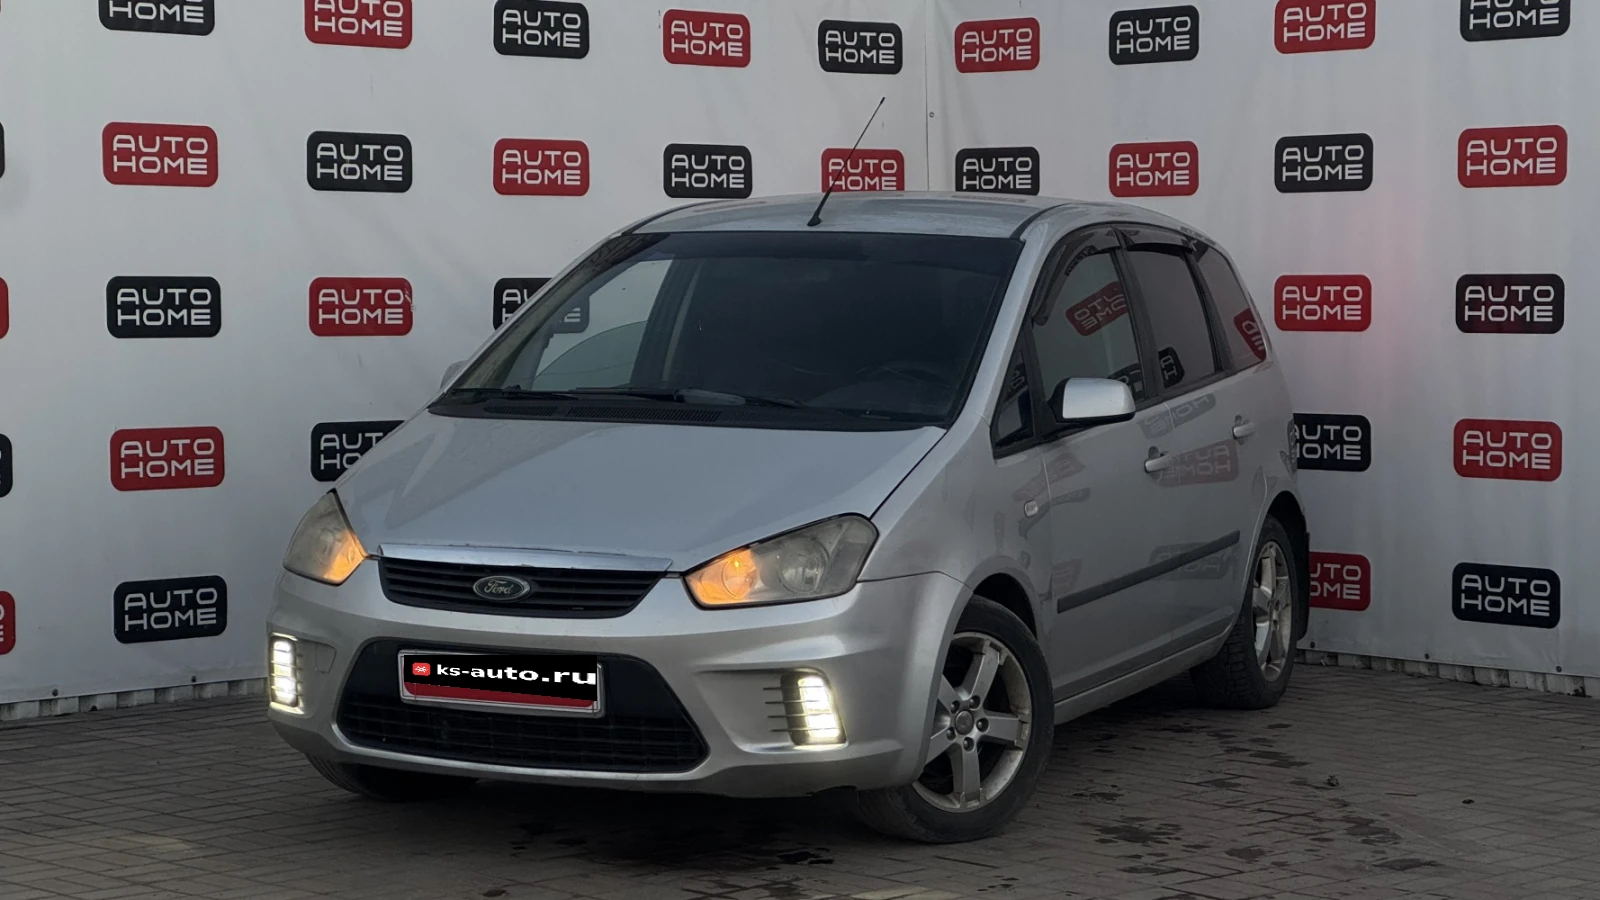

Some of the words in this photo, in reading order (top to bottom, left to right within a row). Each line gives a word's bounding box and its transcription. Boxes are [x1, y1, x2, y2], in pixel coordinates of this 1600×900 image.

[109, 0, 203, 23] HOME
[315, 0, 403, 17] AUTO
[1284, 3, 1366, 23] AUTO
[315, 16, 402, 37] HOME
[503, 9, 580, 28] AUTO
[1117, 17, 1191, 36] AUTO
[1470, 8, 1559, 29] HOME
[503, 28, 580, 47] HOME
[671, 21, 743, 39] AUTO
[826, 31, 895, 46] AUTO
[962, 28, 1032, 45] AUTO
[1284, 22, 1365, 42] HOME
[672, 38, 742, 56] HOME
[1117, 35, 1189, 54] HOME
[826, 48, 894, 64] HOME
[962, 46, 1031, 62] HOME
[113, 135, 208, 154] AUTO
[317, 143, 403, 161] AUTO
[1467, 137, 1557, 156] AUTO
[503, 150, 581, 166] AUTO
[672, 154, 745, 170] AUTO
[1117, 152, 1190, 168] AUTO
[1283, 145, 1364, 163] AUTO
[114, 156, 207, 174] HOME
[317, 163, 402, 181] HOME
[829, 158, 897, 174] AUTO
[964, 158, 1032, 172] AUTO
[1283, 164, 1362, 181] HOME
[1467, 157, 1555, 175] HOME
[502, 169, 580, 185] HOME
[672, 173, 744, 189] HOME
[828, 176, 896, 191] HOME
[963, 175, 1031, 189] HOME
[1117, 170, 1189, 186] HOME
[117, 289, 211, 305] AUTO
[319, 289, 404, 305] AUTO
[1283, 286, 1362, 301] AUTO
[1465, 286, 1554, 301] AUTO
[118, 309, 210, 325] HOME
[319, 309, 403, 324] HOME
[1283, 305, 1361, 320] HOME
[1465, 306, 1552, 321] HOME
[121, 439, 214, 458] AUTO
[320, 433, 383, 451] AUT
[1464, 431, 1552, 449] AUTO
[121, 459, 213, 478] HOME
[320, 452, 362, 471] HO
[1463, 450, 1550, 469] HOME
[484, 579, 514, 595] Ford
[1462, 574, 1550, 596] AUTO
[125, 588, 217, 610] AUTO
[1461, 594, 1549, 616] HOME
[125, 608, 216, 631] HOME
